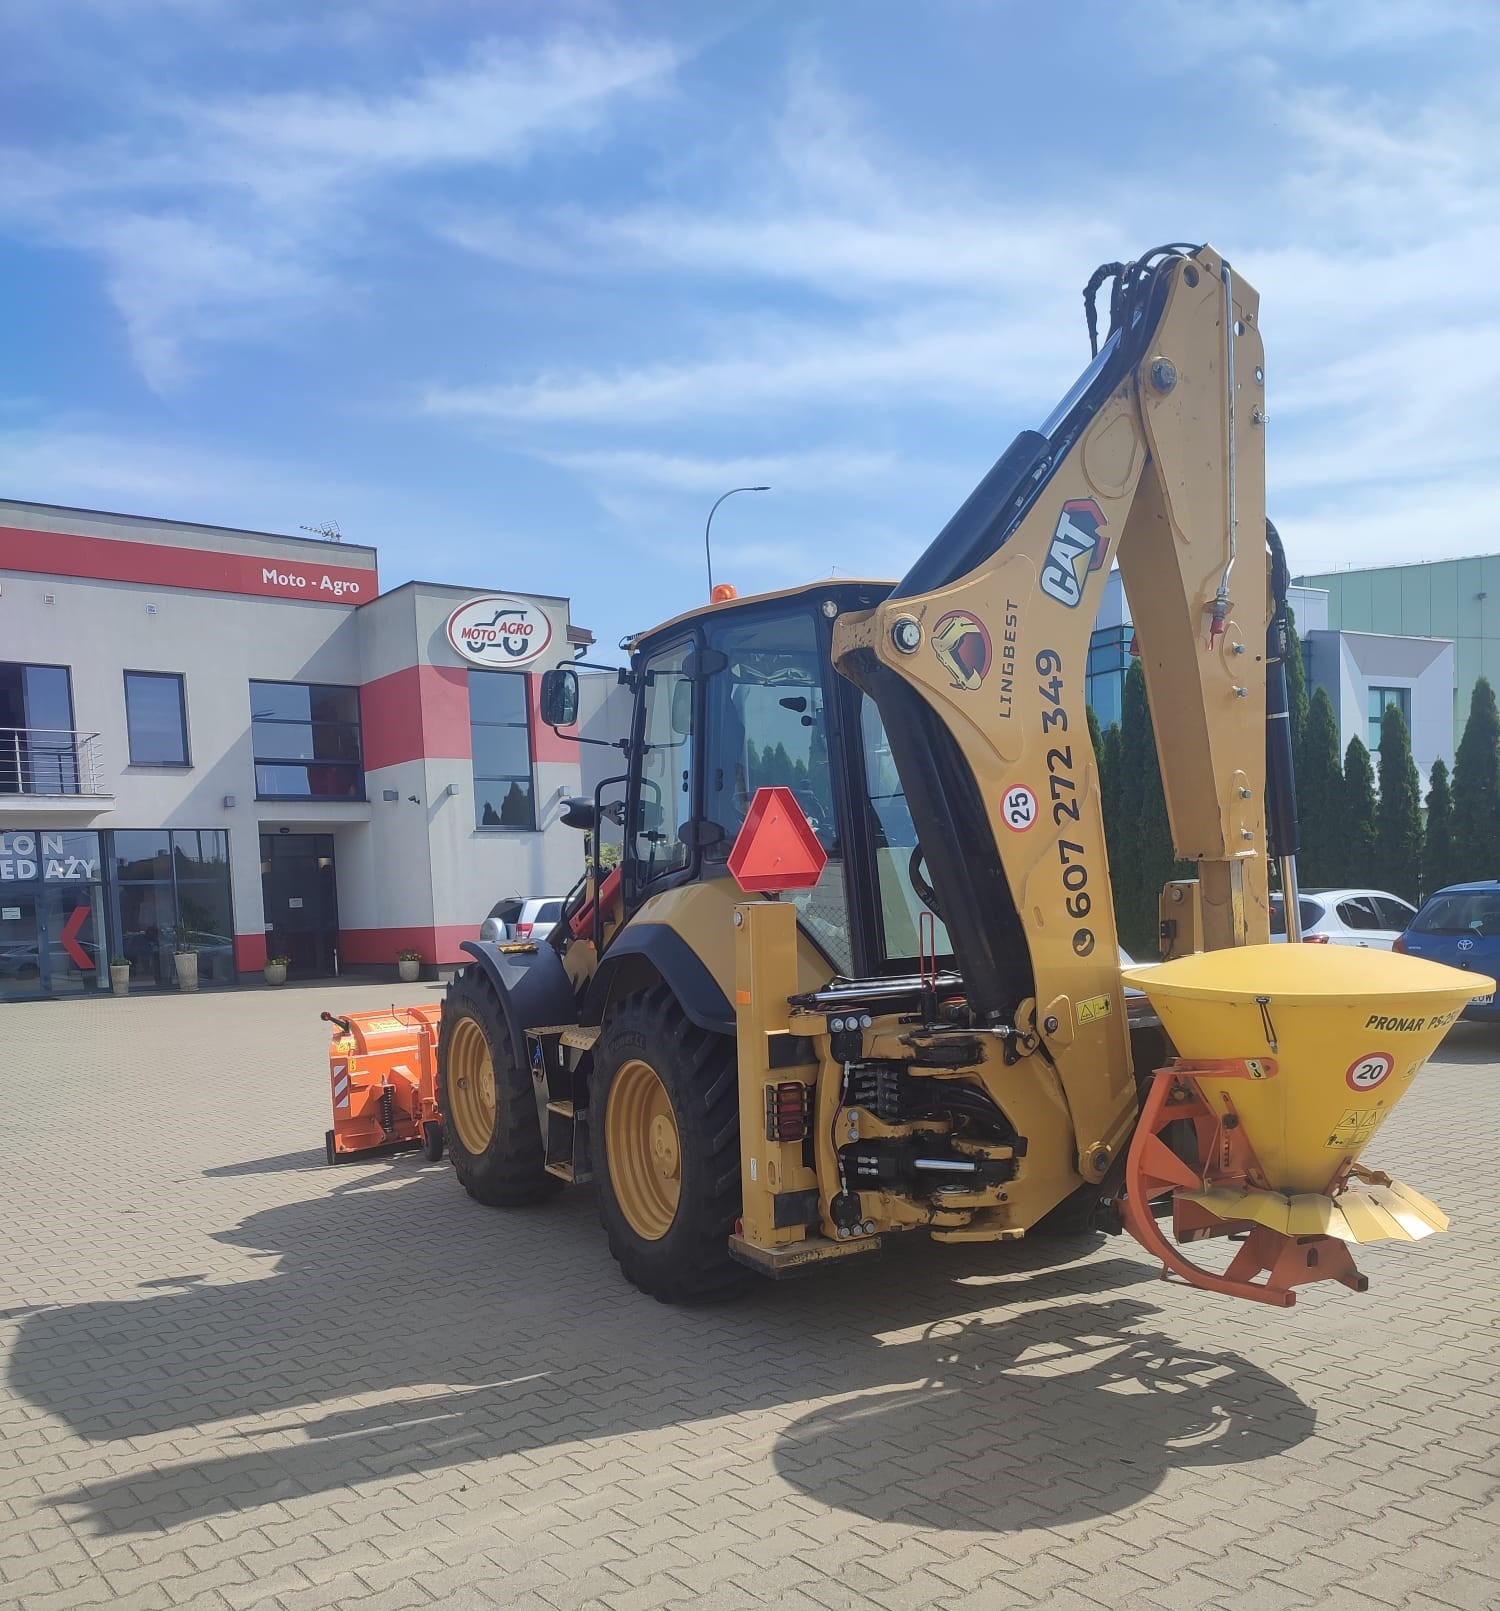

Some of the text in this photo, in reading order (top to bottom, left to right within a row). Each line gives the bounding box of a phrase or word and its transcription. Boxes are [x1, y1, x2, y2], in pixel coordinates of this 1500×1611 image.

[1041, 511, 1096, 607] CAT
[262, 568, 306, 588] Moto
[319, 575, 360, 595] Agro
[461, 621, 533, 642] MOTO AGRO
[1000, 599, 1018, 719] LINGBEST
[1035, 649, 1091, 918] 607 272 349
[1010, 791, 1031, 824] 25
[1365, 1014, 1425, 1032] PRONAR
[1356, 1064, 1384, 1081] 20
